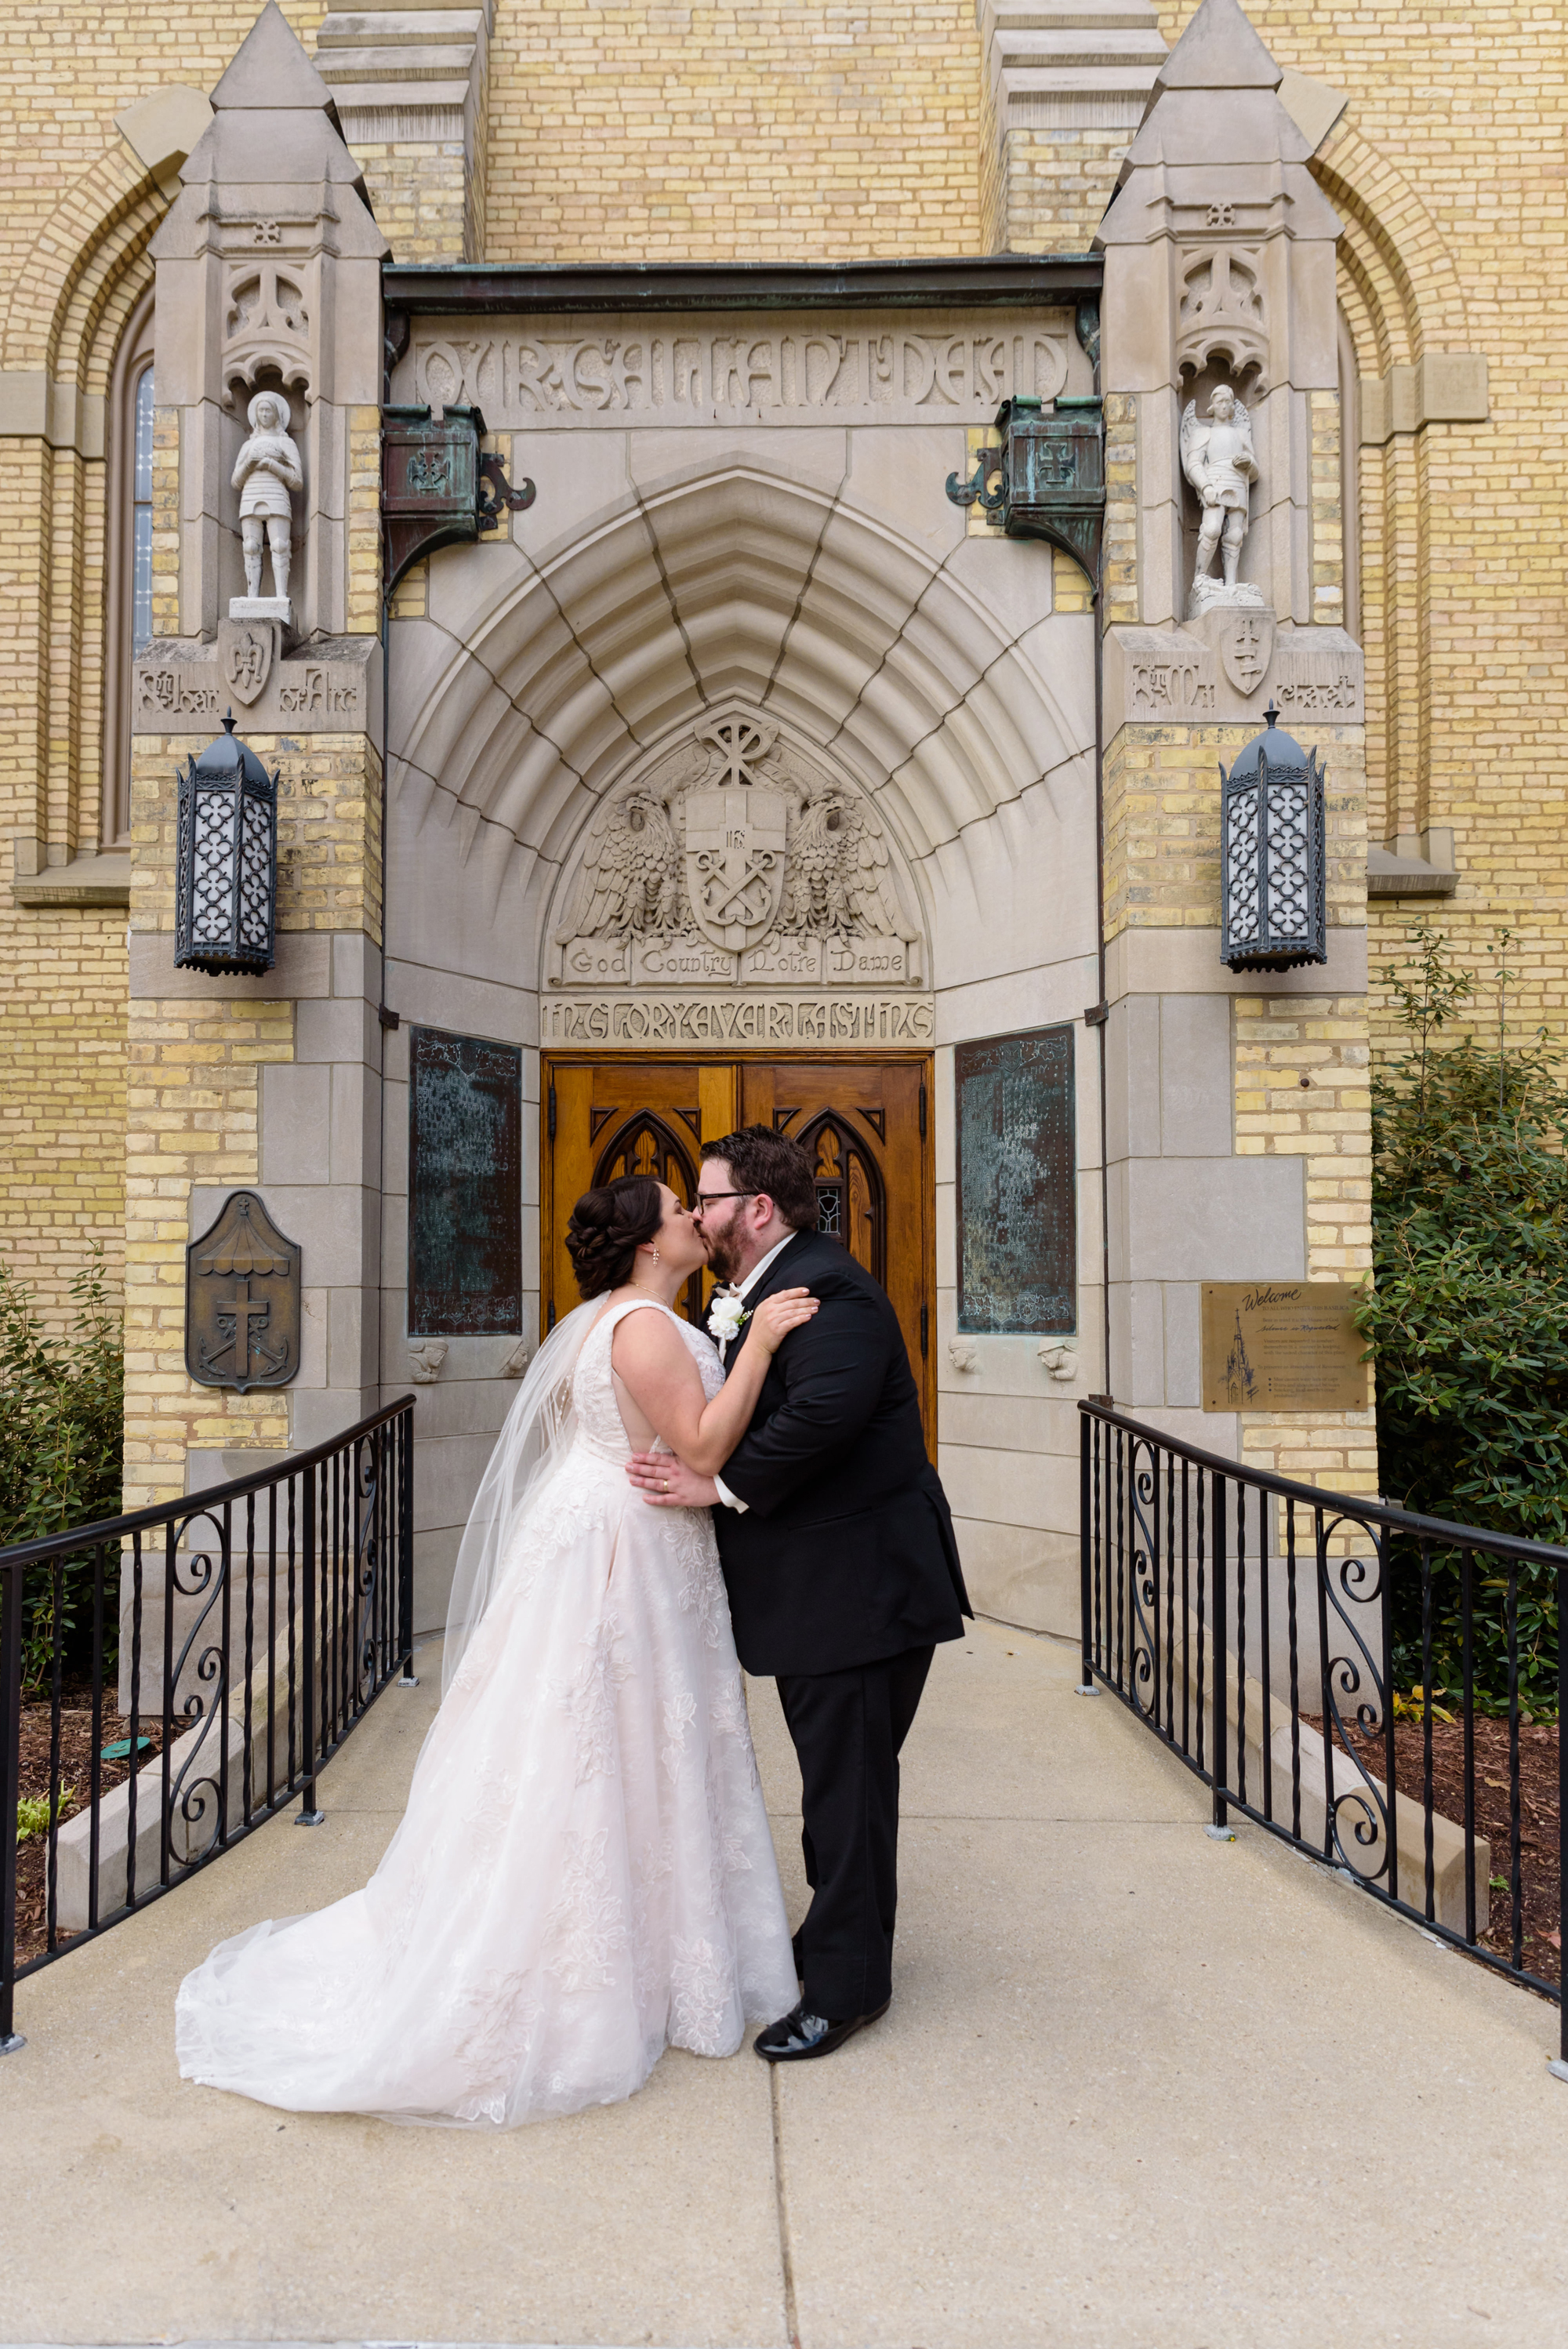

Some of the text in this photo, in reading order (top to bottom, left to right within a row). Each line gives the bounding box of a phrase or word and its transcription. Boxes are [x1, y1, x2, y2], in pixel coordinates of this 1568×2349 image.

[416, 334, 1069, 411] OUR GALLANT DEAD
[569, 947, 902, 977] God Country Notre Dame
[1242, 1287, 1302, 1312] Welcome
